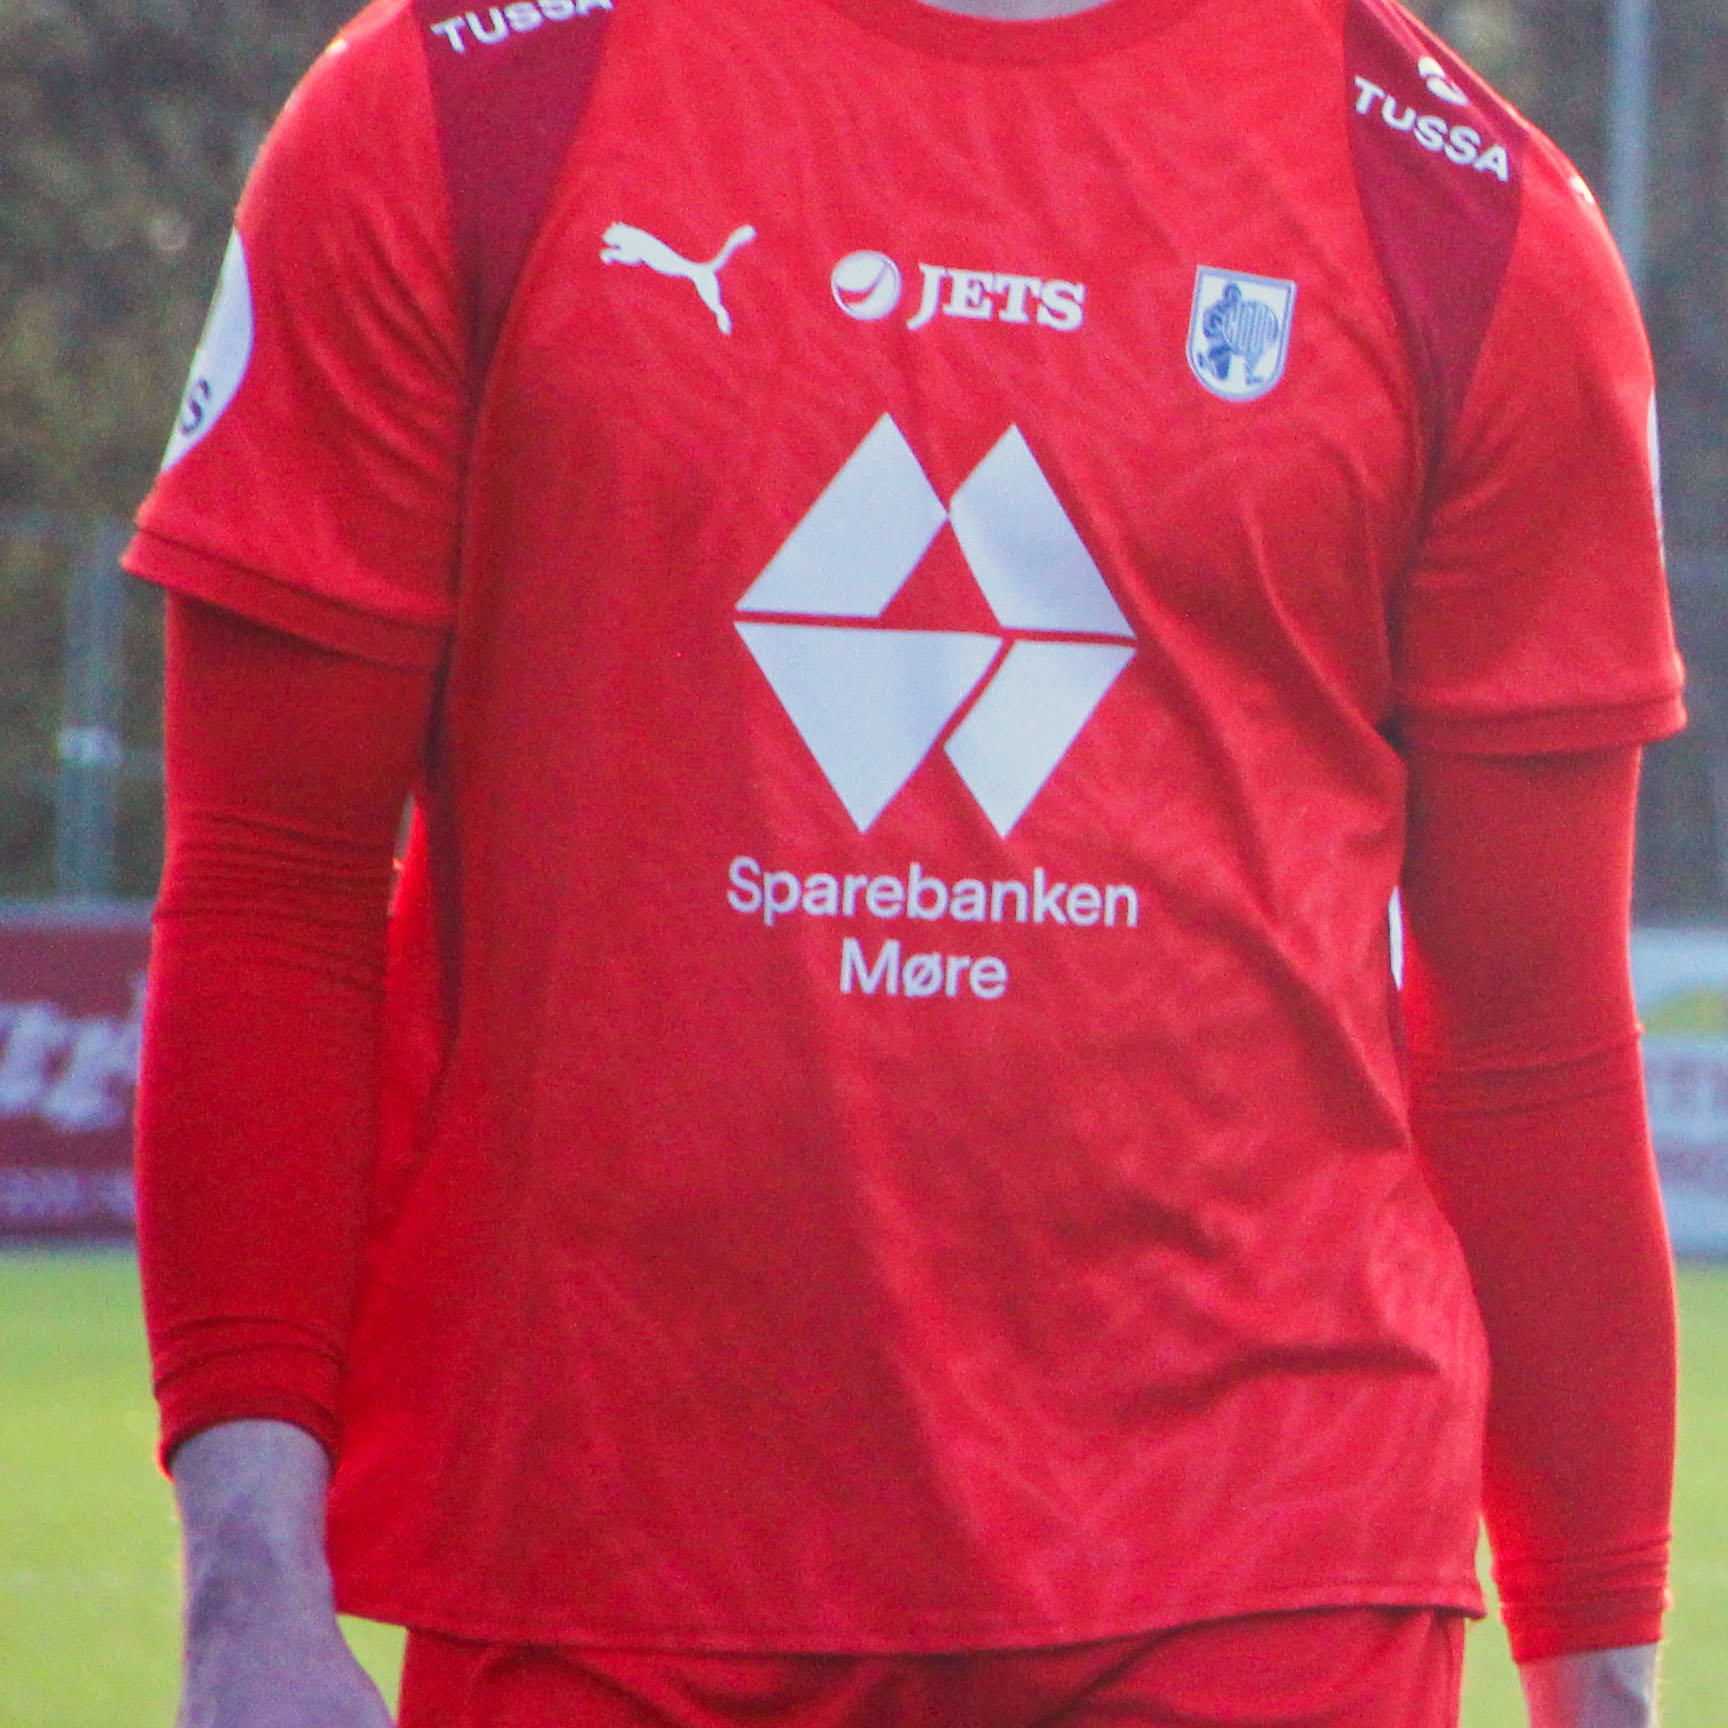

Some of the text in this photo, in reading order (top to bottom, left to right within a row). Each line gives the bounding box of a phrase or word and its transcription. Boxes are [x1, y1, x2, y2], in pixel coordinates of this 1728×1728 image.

[1353, 75, 1511, 183] TUSSA
[907, 263, 1085, 332] JETS
[726, 854, 1140, 928] Sparebanken
[839, 936, 1009, 1000] Møre
